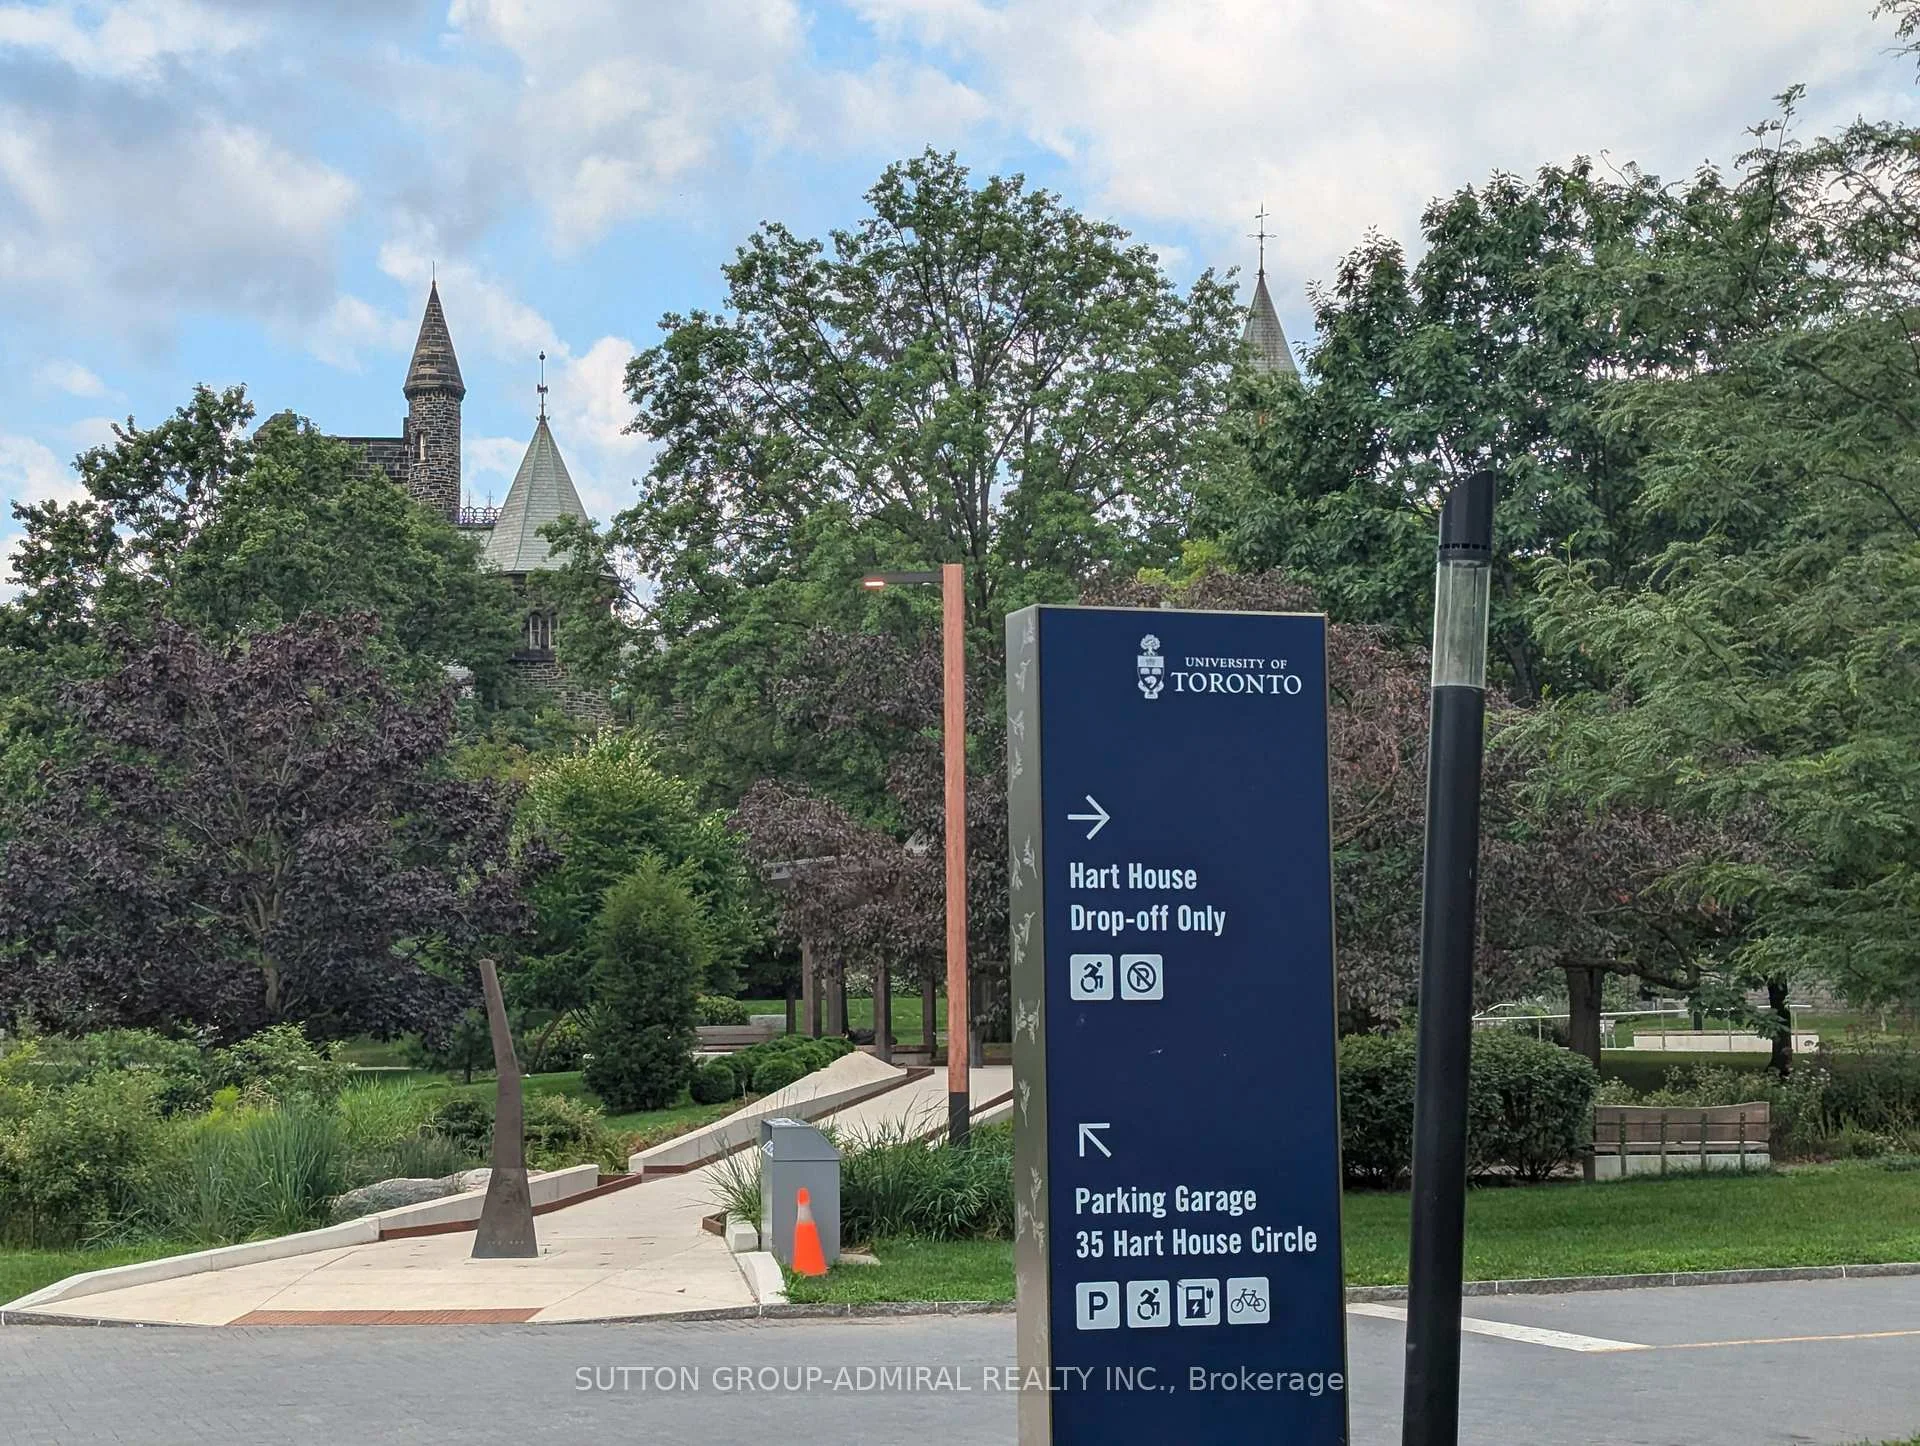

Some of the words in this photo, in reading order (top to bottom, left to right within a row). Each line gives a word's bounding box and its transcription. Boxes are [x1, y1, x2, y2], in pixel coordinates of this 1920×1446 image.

[1185, 656, 1265, 669] UNIVERSITY
[1270, 659, 1288, 670] OF
[1171, 671, 1302, 695] TORONTO
[1070, 862, 1120, 890] Hart
[1128, 862, 1197, 890] House
[1070, 904, 1169, 937] Drop-off
[1178, 904, 1226, 937] Only
[1075, 1187, 1167, 1218] Parking
[1175, 1185, 1257, 1217] Garage
[1076, 1230, 1104, 1259] 35
[1113, 1230, 1164, 1257] Hart
[1172, 1229, 1242, 1255] House
[1251, 1225, 1317, 1253] Circle
[1088, 1291, 1108, 1320] P
